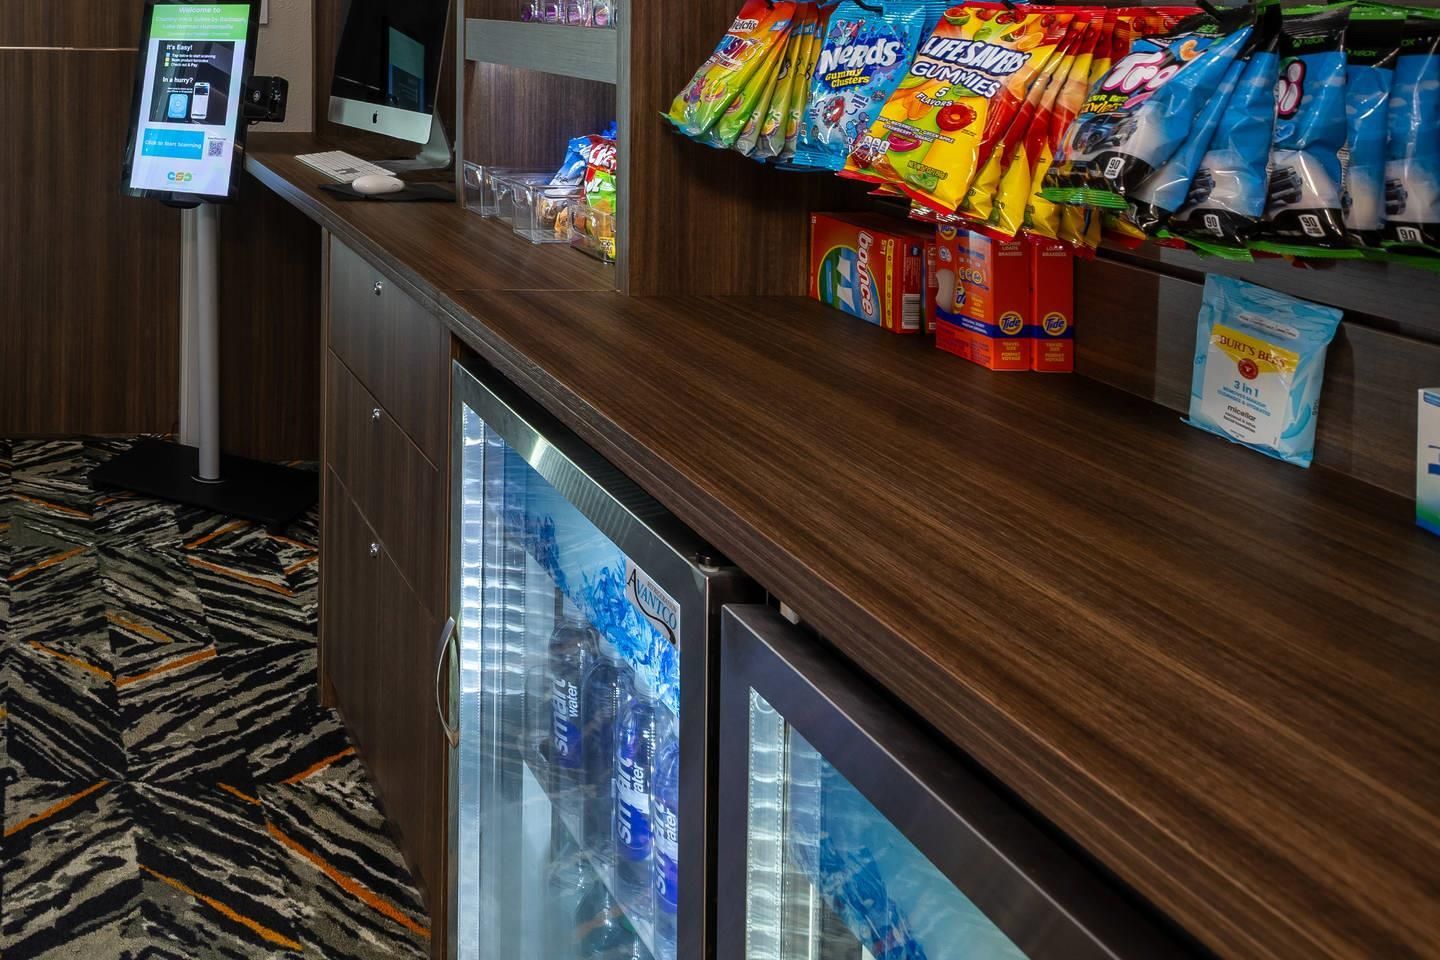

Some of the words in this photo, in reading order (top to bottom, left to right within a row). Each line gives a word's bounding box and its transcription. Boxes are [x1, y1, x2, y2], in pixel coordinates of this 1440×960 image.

[910, 62, 1001, 98] GUMMIES
[1102, 51, 1180, 94] Tro
[831, 75, 871, 89] Clusters
[935, 87, 949, 97] 5
[916, 93, 953, 107] FLAVORS
[1109, 159, 1121, 170] 90
[1206, 214, 1218, 229] 90
[1302, 216, 1318, 228] 90
[1401, 229, 1417, 240] 90
[1002, 316, 1021, 330] Tide
[1045, 317, 1065, 331] Tide
[1219, 335, 1256, 357] BURT'S
[1257, 349, 1287, 369] BEES
[1233, 380, 1240, 390] 3
[1242, 383, 1252, 396] in
[1254, 388, 1259, 398] 1
[1227, 404, 1257, 422] micellar
[626, 568, 678, 632] AVANTCO
[568, 681, 578, 719] water
[551, 678, 568, 757] smart
